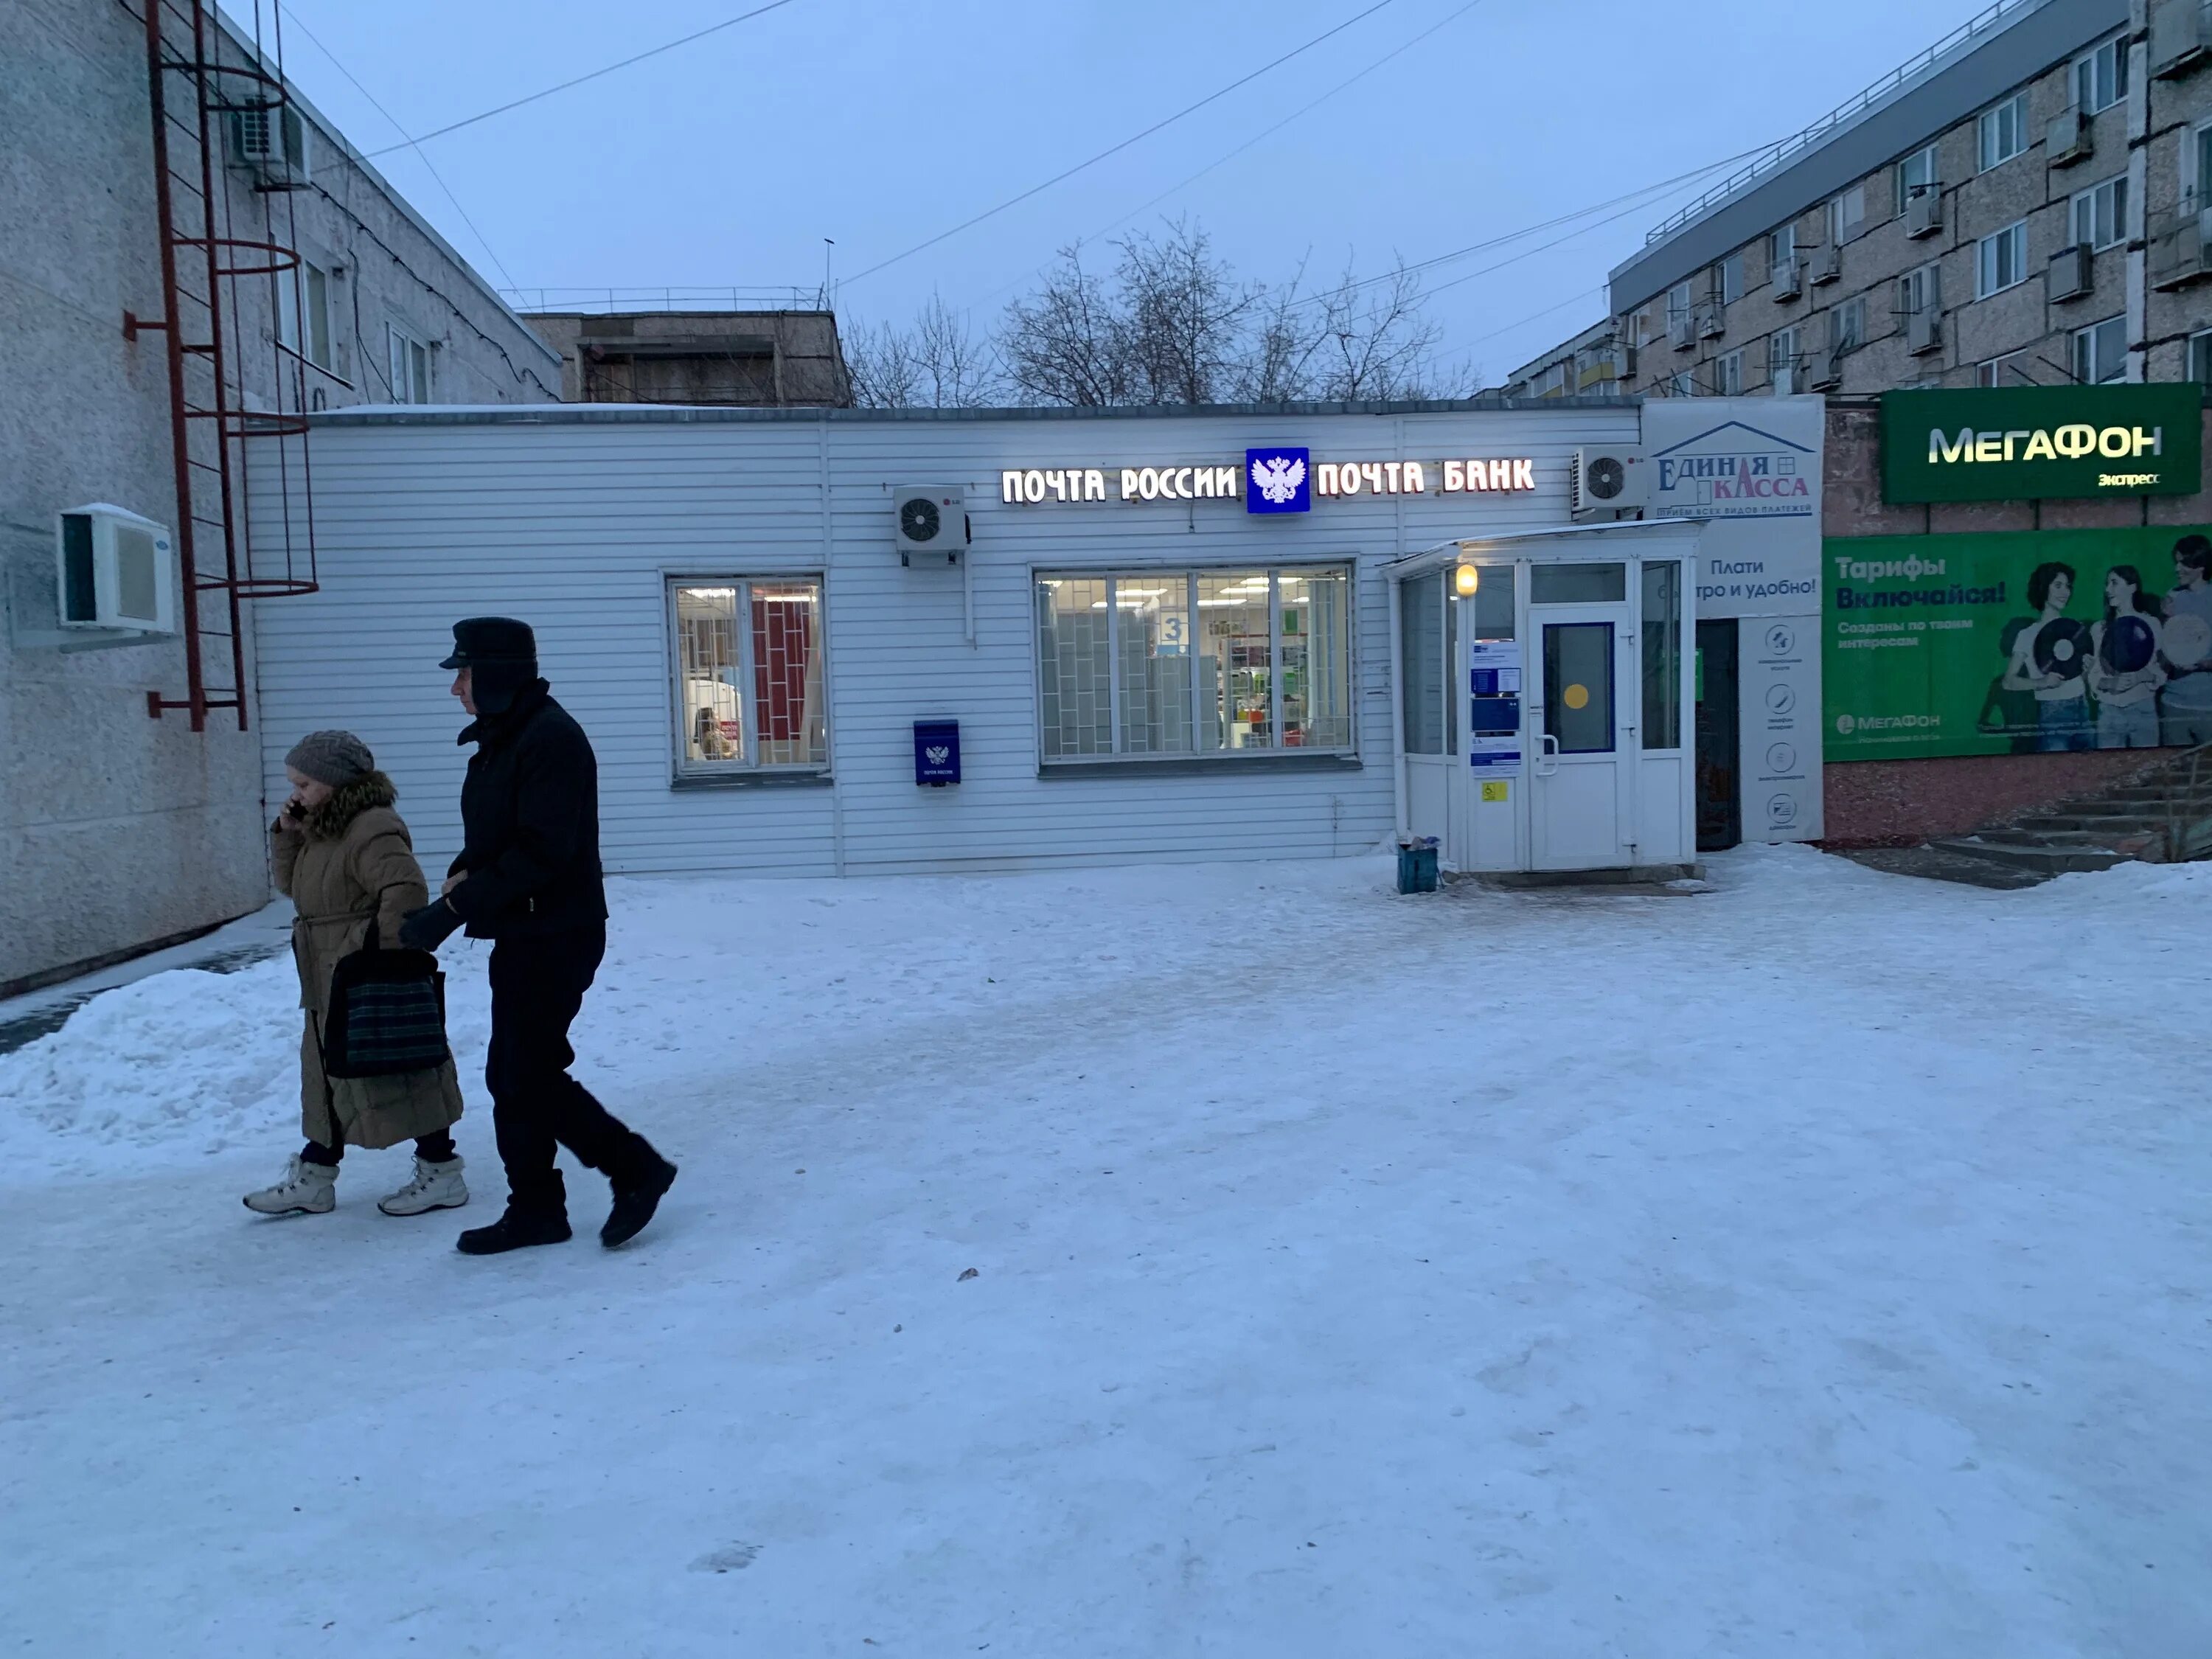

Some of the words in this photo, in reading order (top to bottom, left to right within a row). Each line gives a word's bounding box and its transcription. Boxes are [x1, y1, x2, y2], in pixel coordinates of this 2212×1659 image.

[1929, 424, 2162, 463] МЕГАФОН
[1001, 469, 1106, 503] ПОЧТА
[1120, 465, 1237, 501] РОССИИ
[1318, 462, 1425, 496] ПОЧТА
[1443, 459, 1536, 493] БАНК
[1658, 456, 1769, 493] ЕДИНАЯ
[1714, 472, 1809, 499] КАССА
[1697, 507, 1721, 515] ВСЕХ
[1725, 506, 1758, 515] ВИДОВ
[1761, 503, 1812, 514] ПЛАТЕЖЕЙ
[1711, 560, 1764, 574] Плати
[1834, 554, 1946, 583] Тарифы
[1730, 585, 1741, 597] и
[1746, 579, 1817, 599] удобно!
[1836, 581, 2006, 609] Включайся!
[1164, 617, 1183, 640] 3
[1838, 622, 1905, 635] Созданы
[1908, 621, 1927, 630] по
[1929, 619, 1974, 630] твоим
[1838, 636, 1919, 650] интересам
